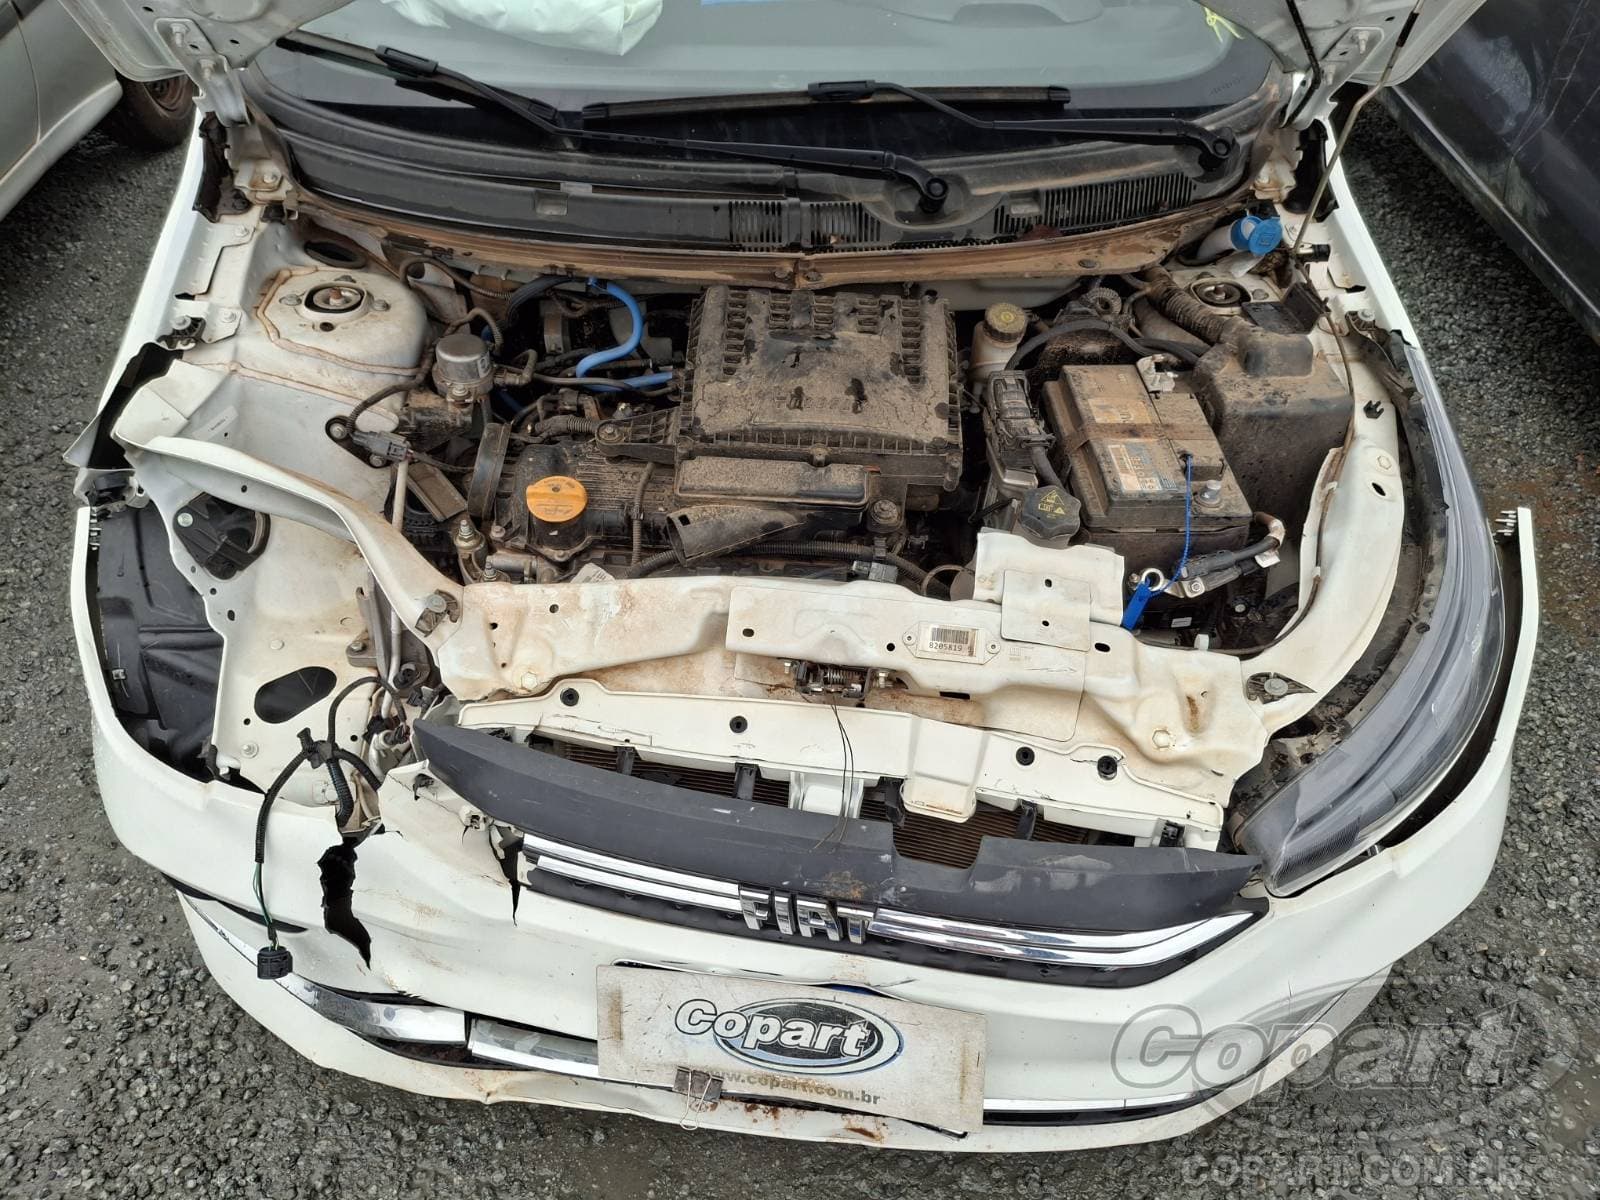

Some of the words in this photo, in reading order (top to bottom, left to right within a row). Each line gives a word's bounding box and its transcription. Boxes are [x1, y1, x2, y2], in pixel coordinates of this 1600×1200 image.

[739, 888, 874, 945] FIAT
[675, 997, 870, 1057] Copart
[698, 1068, 881, 1105] ww.copart.com.br
